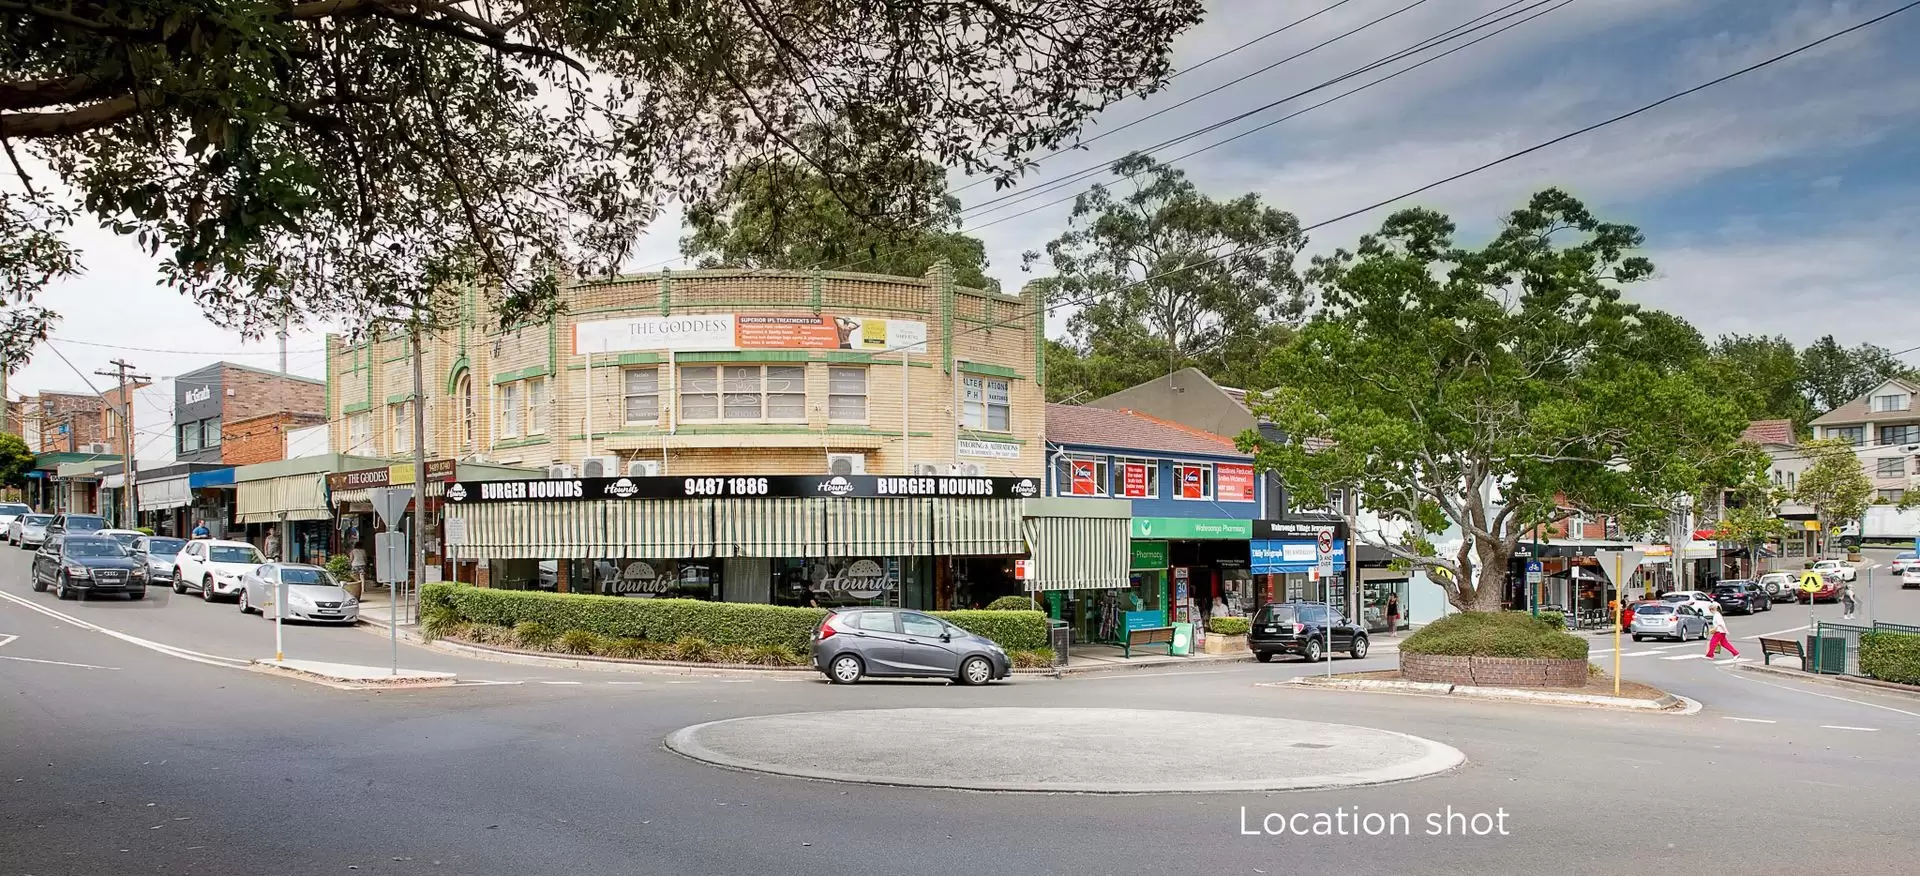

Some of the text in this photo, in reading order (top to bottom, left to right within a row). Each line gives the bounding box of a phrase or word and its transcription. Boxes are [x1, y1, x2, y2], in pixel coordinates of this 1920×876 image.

[628, 319, 728, 335] THE GODDESS
[778, 317, 810, 325] TREATMENTS
[185, 384, 210, 405] McGrath
[348, 473, 360, 484] THE
[360, 470, 388, 484] GODDESS
[446, 486, 467, 498] Hounds
[481, 481, 583, 499] BURGER HOUNDS
[604, 482, 639, 494] Hounds
[685, 478, 768, 495] 9487 1886
[817, 480, 854, 492] Hounds
[877, 478, 993, 495] BURGER HOUNDS
[1011, 481, 1037, 493] Hounds
[1195, 525, 1245, 534] Wahroonga Pharmacy
[1136, 550, 1163, 561] Pharmacy
[601, 570, 670, 593] Hounds
[819, 568, 896, 591] Hounds
